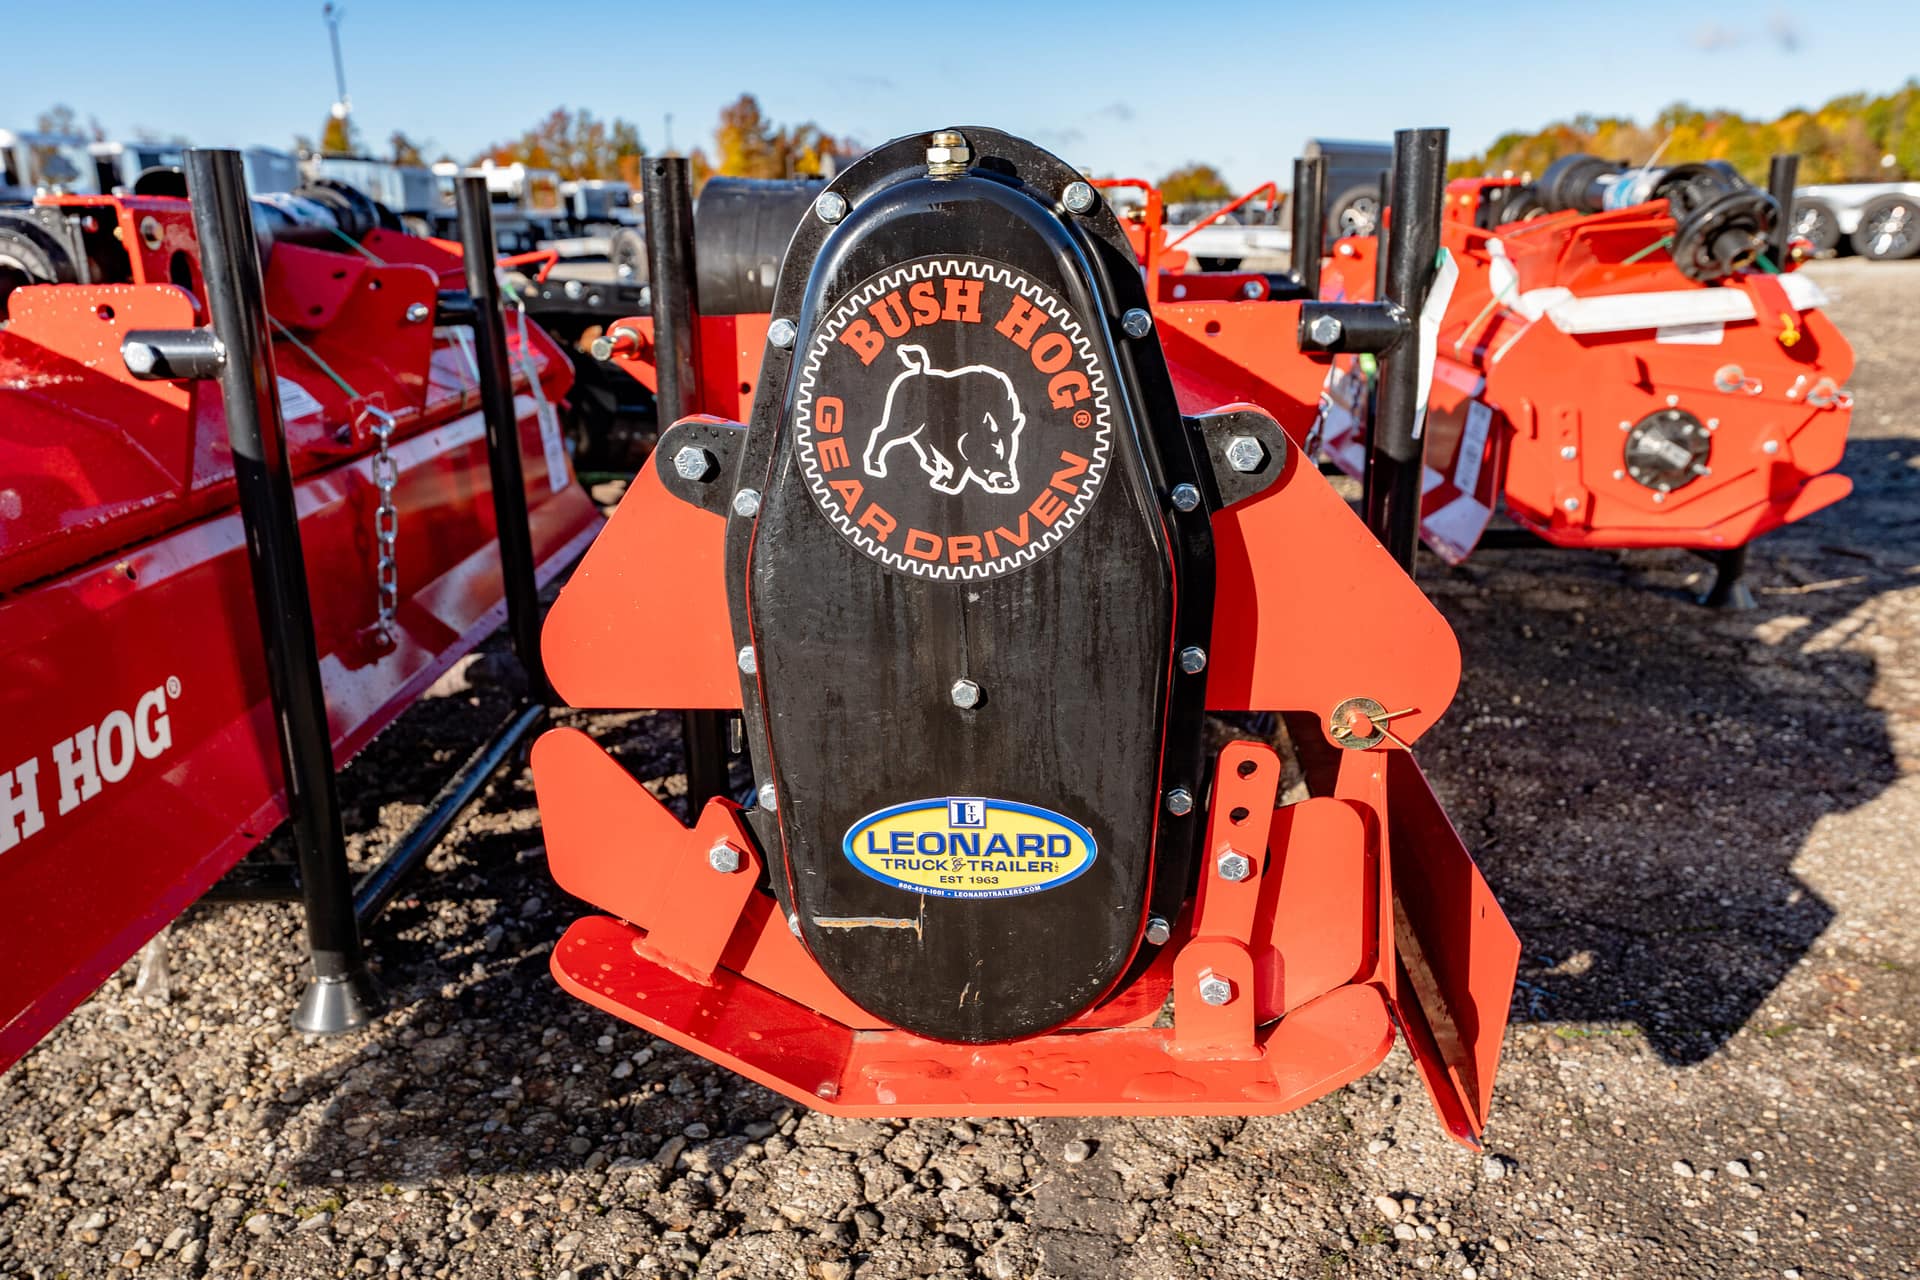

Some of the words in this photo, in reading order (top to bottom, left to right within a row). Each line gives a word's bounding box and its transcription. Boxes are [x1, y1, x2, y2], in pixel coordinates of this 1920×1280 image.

[838, 277, 985, 367] BUSH
[815, 396, 897, 543] GEAR
[903, 450, 1090, 565] DRIVEN
[867, 830, 1071, 858] LEONARD
[881, 858, 948, 871] TRUCK
[967, 860, 1053, 872] TRAILER
[939, 875, 963, 884] EST
[969, 876, 999, 884] 1963
[954, 885, 1041, 898] LEONARDTRAILERS.COM
